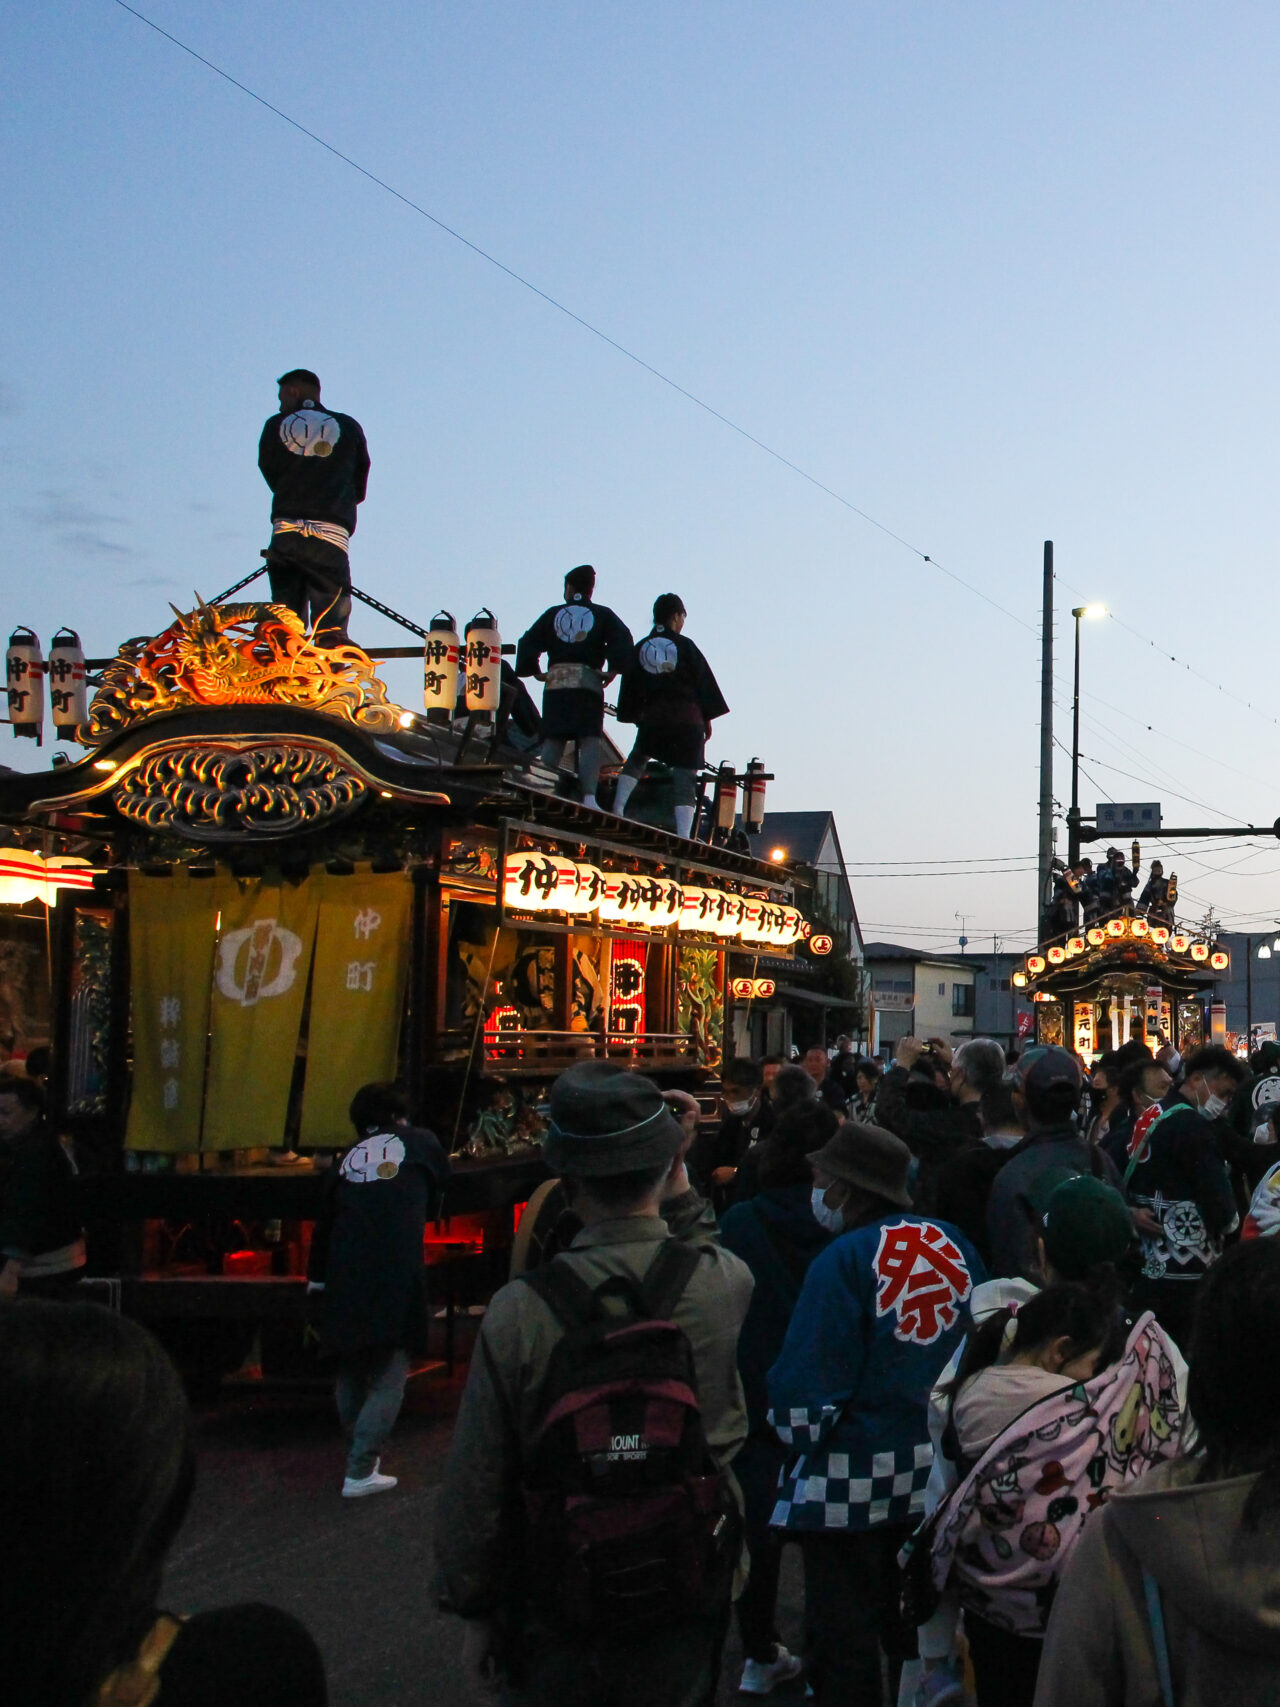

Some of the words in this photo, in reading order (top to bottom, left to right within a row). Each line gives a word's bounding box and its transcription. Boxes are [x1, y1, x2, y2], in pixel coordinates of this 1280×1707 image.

[7, 657, 30, 712] 仲町
[51, 658, 74, 713] 仲町
[425, 640, 448, 696] 仲町
[467, 641, 490, 699] 仲町
[518, 857, 559, 900] 仲
[346, 907, 381, 991] 仲町
[1078, 1018, 1091, 1048] 元町
[872, 1219, 972, 1345] 祭
